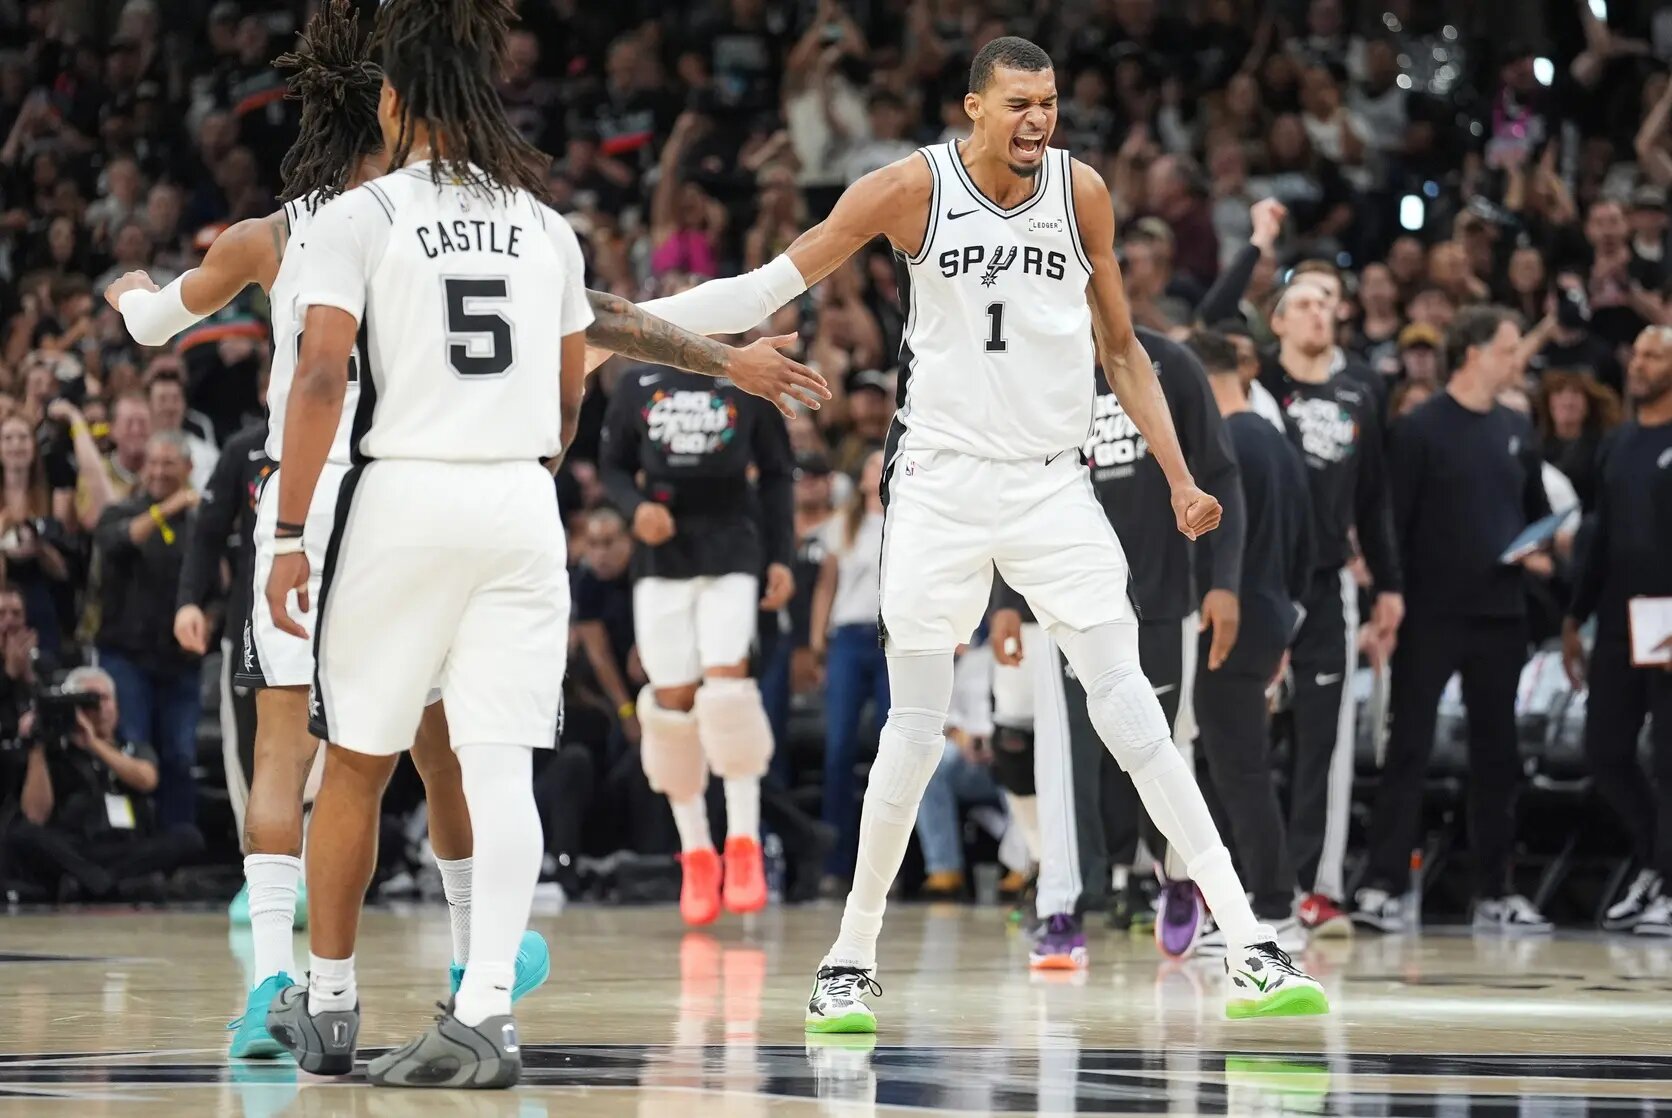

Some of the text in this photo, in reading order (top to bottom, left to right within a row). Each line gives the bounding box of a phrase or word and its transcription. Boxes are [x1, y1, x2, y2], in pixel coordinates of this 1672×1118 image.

[417, 220, 522, 258] CASTLE
[1032, 220, 1060, 230] LEDGER
[940, 245, 1066, 288] SPURS
[439, 274, 517, 380] 5
[984, 301, 1008, 353] 1
